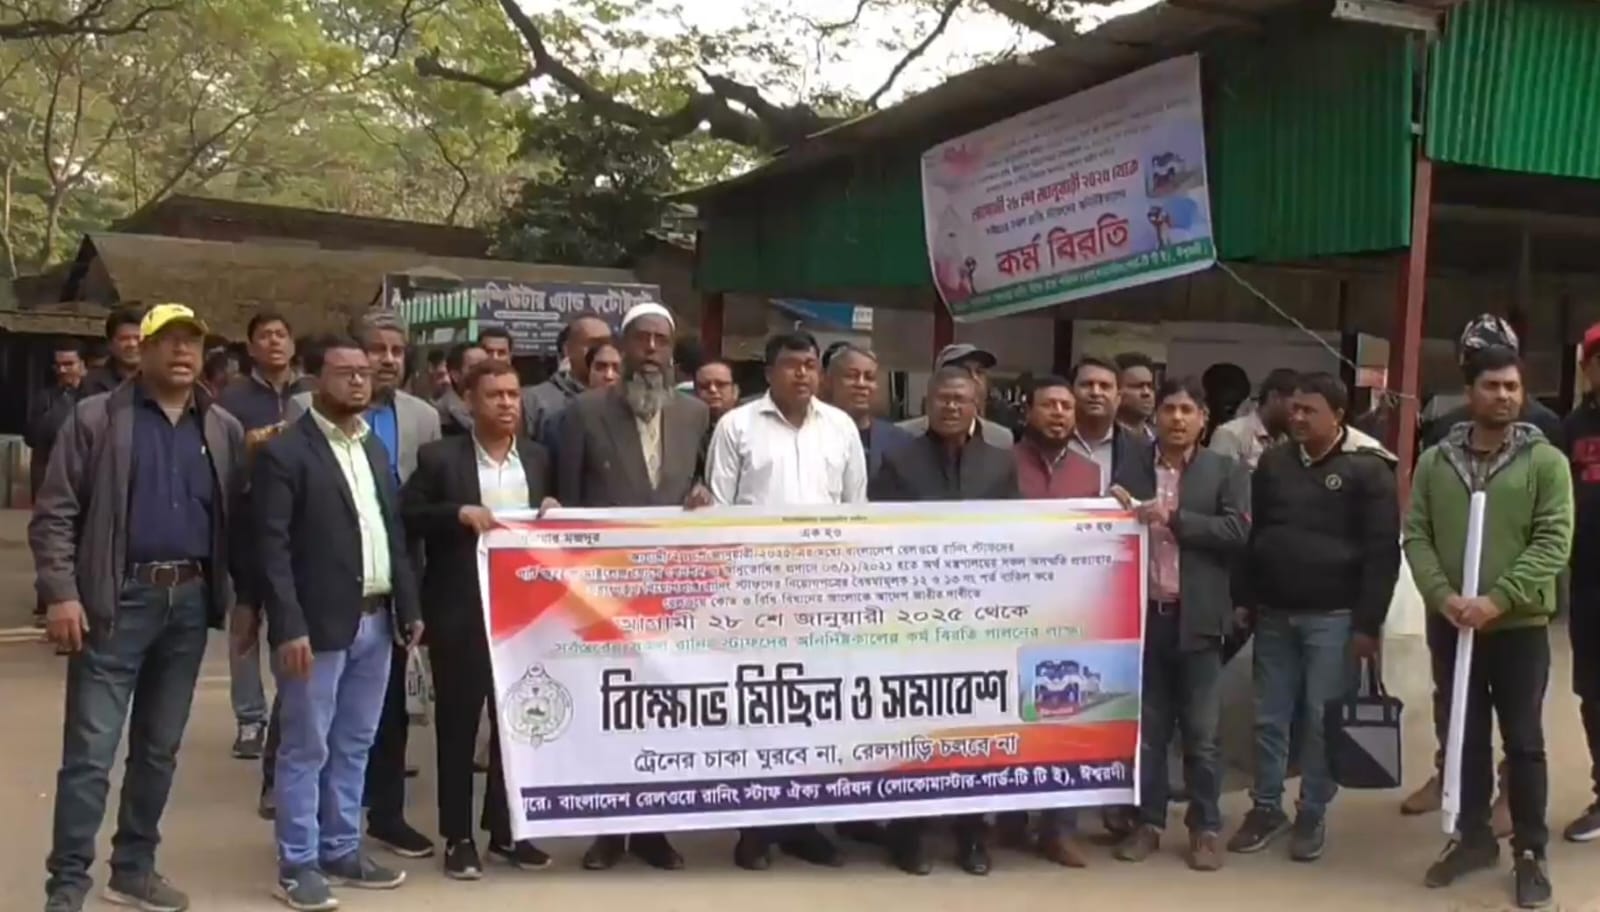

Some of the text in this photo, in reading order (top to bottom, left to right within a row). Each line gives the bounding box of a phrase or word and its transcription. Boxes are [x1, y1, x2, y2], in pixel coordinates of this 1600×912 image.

[996, 233, 1042, 277] কর্ম
[1047, 213, 1130, 268] বিরতি
[621, 603, 1032, 632] আগামী ২৮ শে জানুয়ারী ২০২৫ থেকে
[935, 625, 978, 643] বিরতি
[600, 662, 1008, 731] বিক্ষোভ মিছিল ও সমাবেশ
[634, 732, 1020, 774] ট্রেনের চাকা ঘুরবে না, রেলগাড়ি চলবে না
[557, 792, 631, 811] বাংলাদেশ
[635, 789, 697, 808] রেলওয়ে
[701, 783, 741, 805] রানিং
[743, 782, 782, 803] স্টাফ
[786, 779, 821, 801] ঐক্য
[825, 776, 873, 798] পরিষদ
[1033, 764, 1048, 786] টি
[1079, 760, 1126, 783] ঈশ্বরদী
